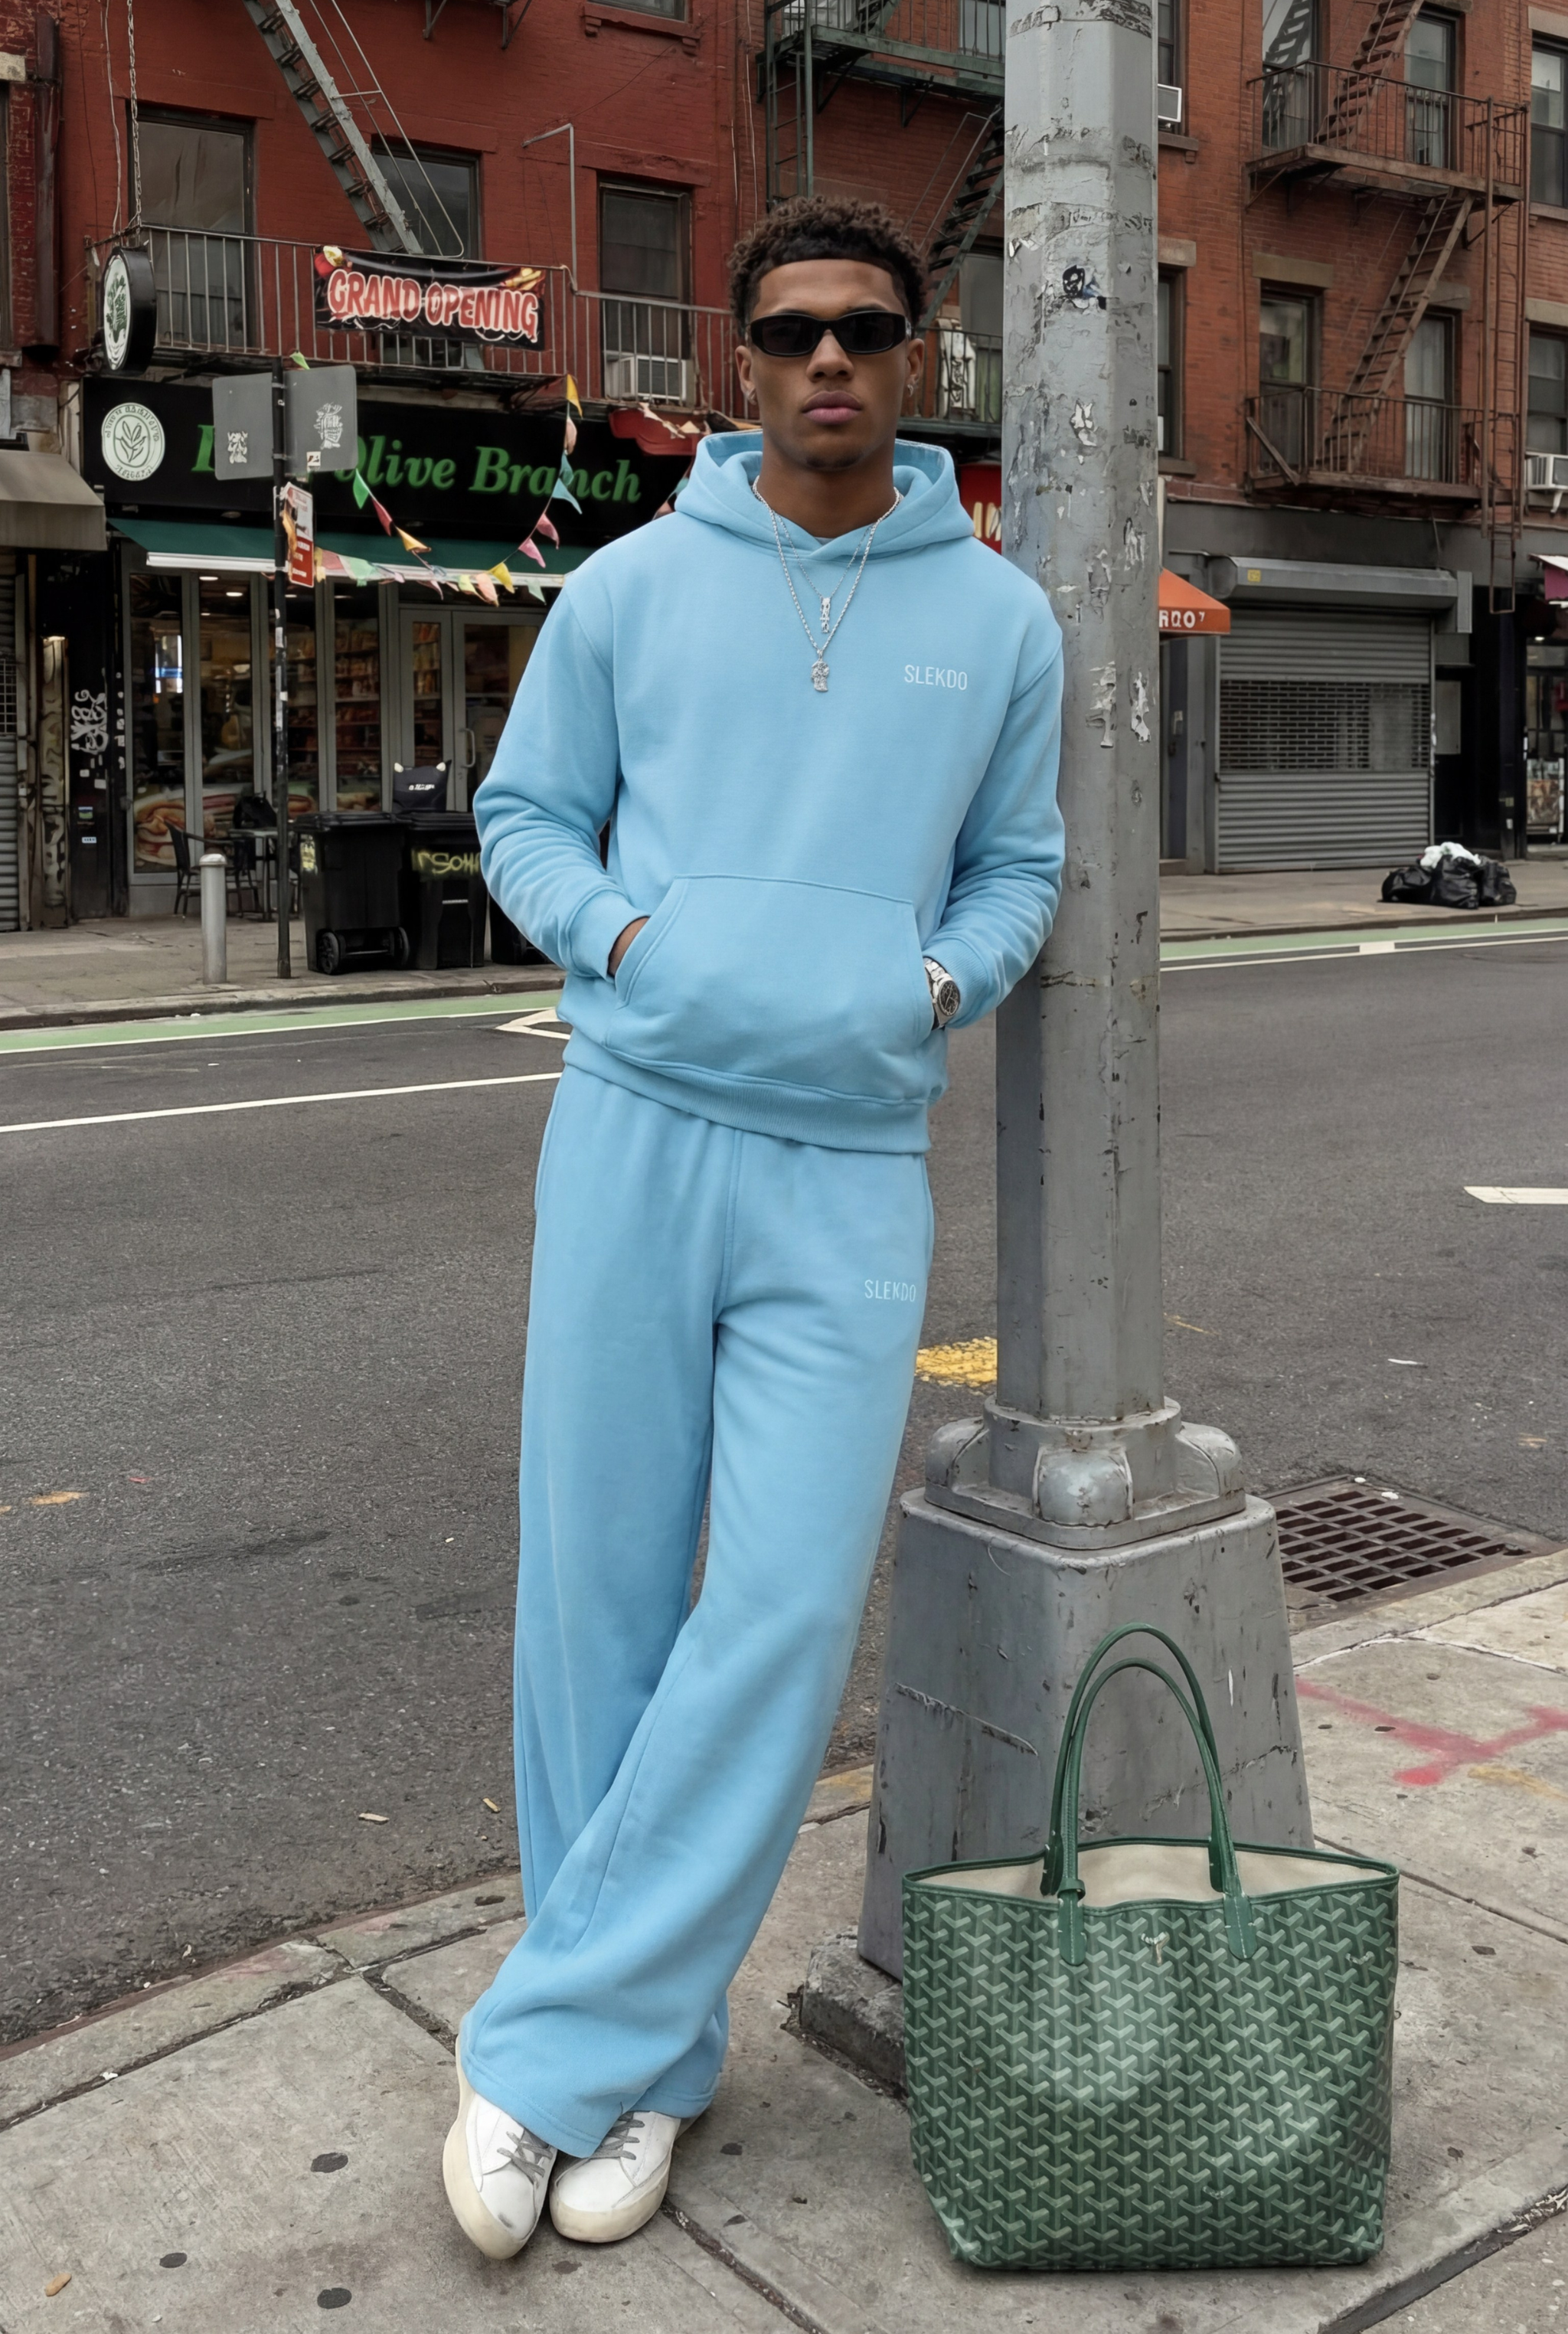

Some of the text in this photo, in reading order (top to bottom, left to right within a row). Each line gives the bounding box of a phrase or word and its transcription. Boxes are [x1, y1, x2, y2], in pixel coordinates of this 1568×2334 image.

[327, 269, 539, 343] GRAND OPENING
[468, 446, 642, 504] Branch
[904, 664, 968, 691] SLEKDO
[864, 1279, 916, 1303] SLEKDO
